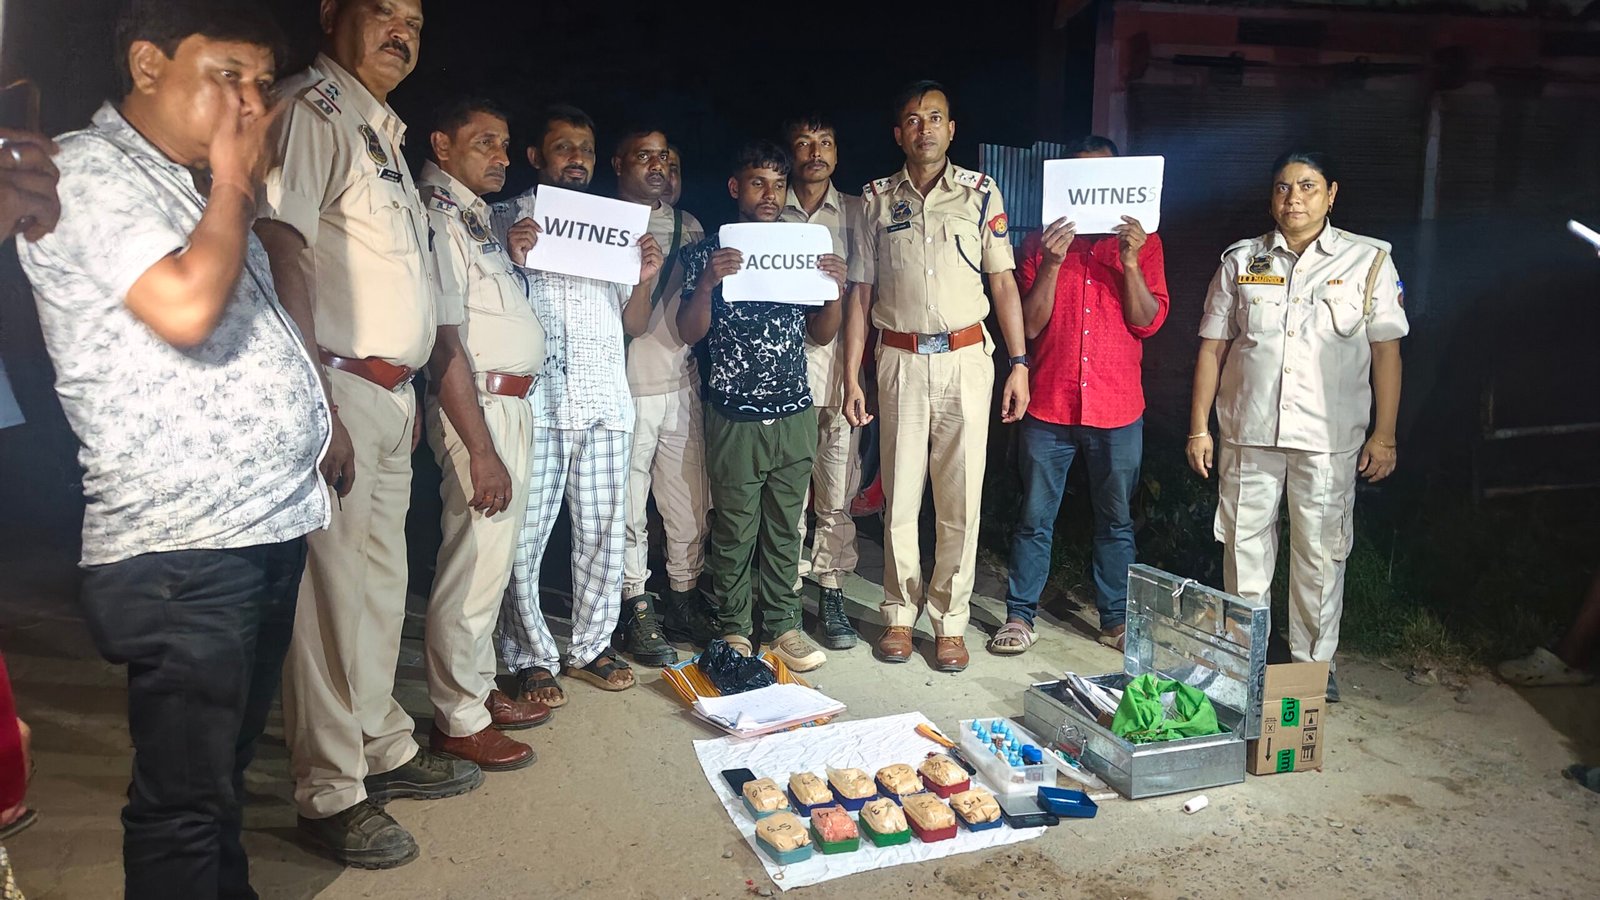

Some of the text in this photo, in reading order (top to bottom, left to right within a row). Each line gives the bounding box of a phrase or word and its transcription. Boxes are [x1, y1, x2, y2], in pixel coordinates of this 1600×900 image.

[1068, 187, 1156, 205] WITNESS
[964, 797, 981, 809] S-1
[766, 823, 792, 833] S-5
